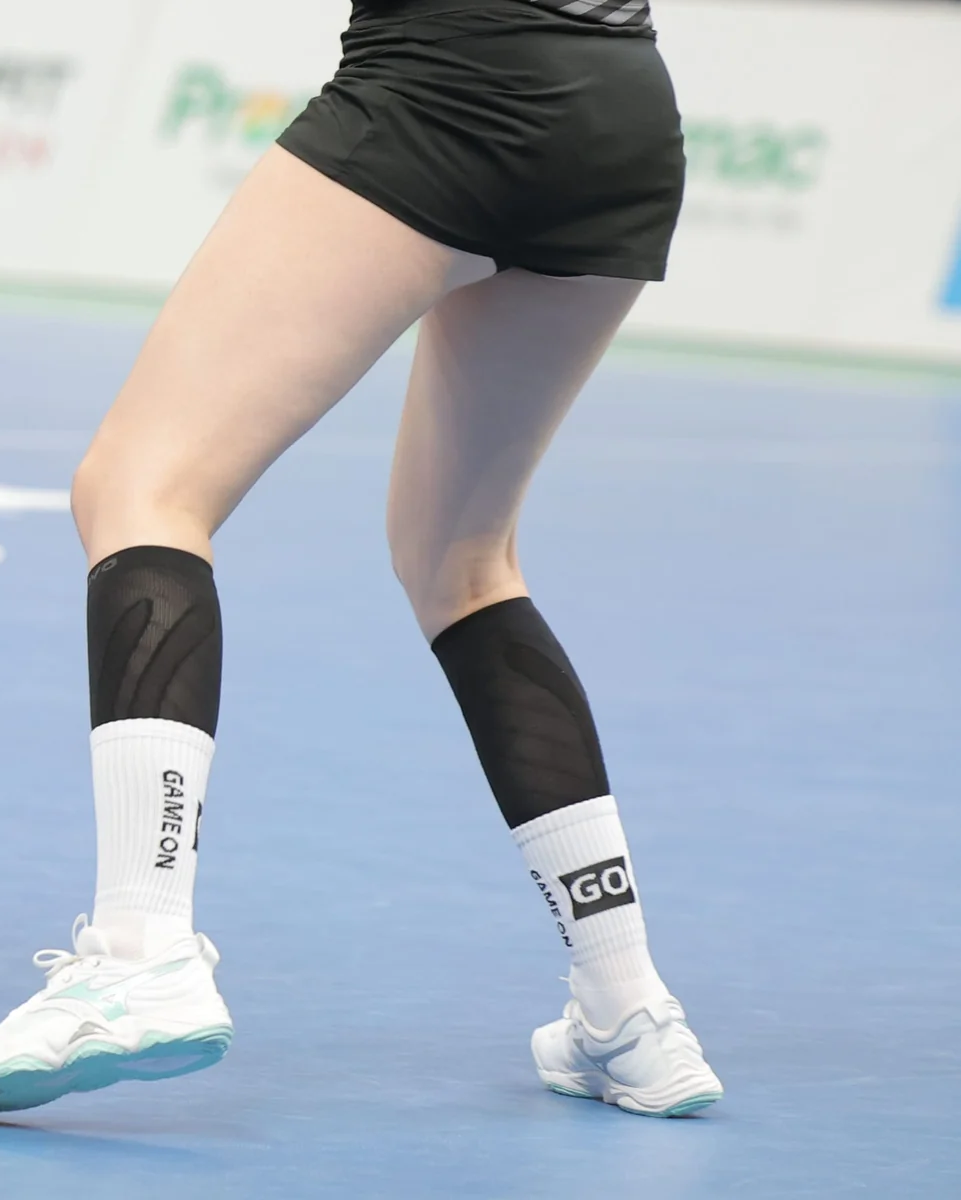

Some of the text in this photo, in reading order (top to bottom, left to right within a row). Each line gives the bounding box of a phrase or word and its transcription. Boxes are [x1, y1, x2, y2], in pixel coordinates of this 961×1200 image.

[155, 769, 184, 870] GAME ON
[530, 869, 562, 917] GAME
[569, 865, 630, 904] GO
